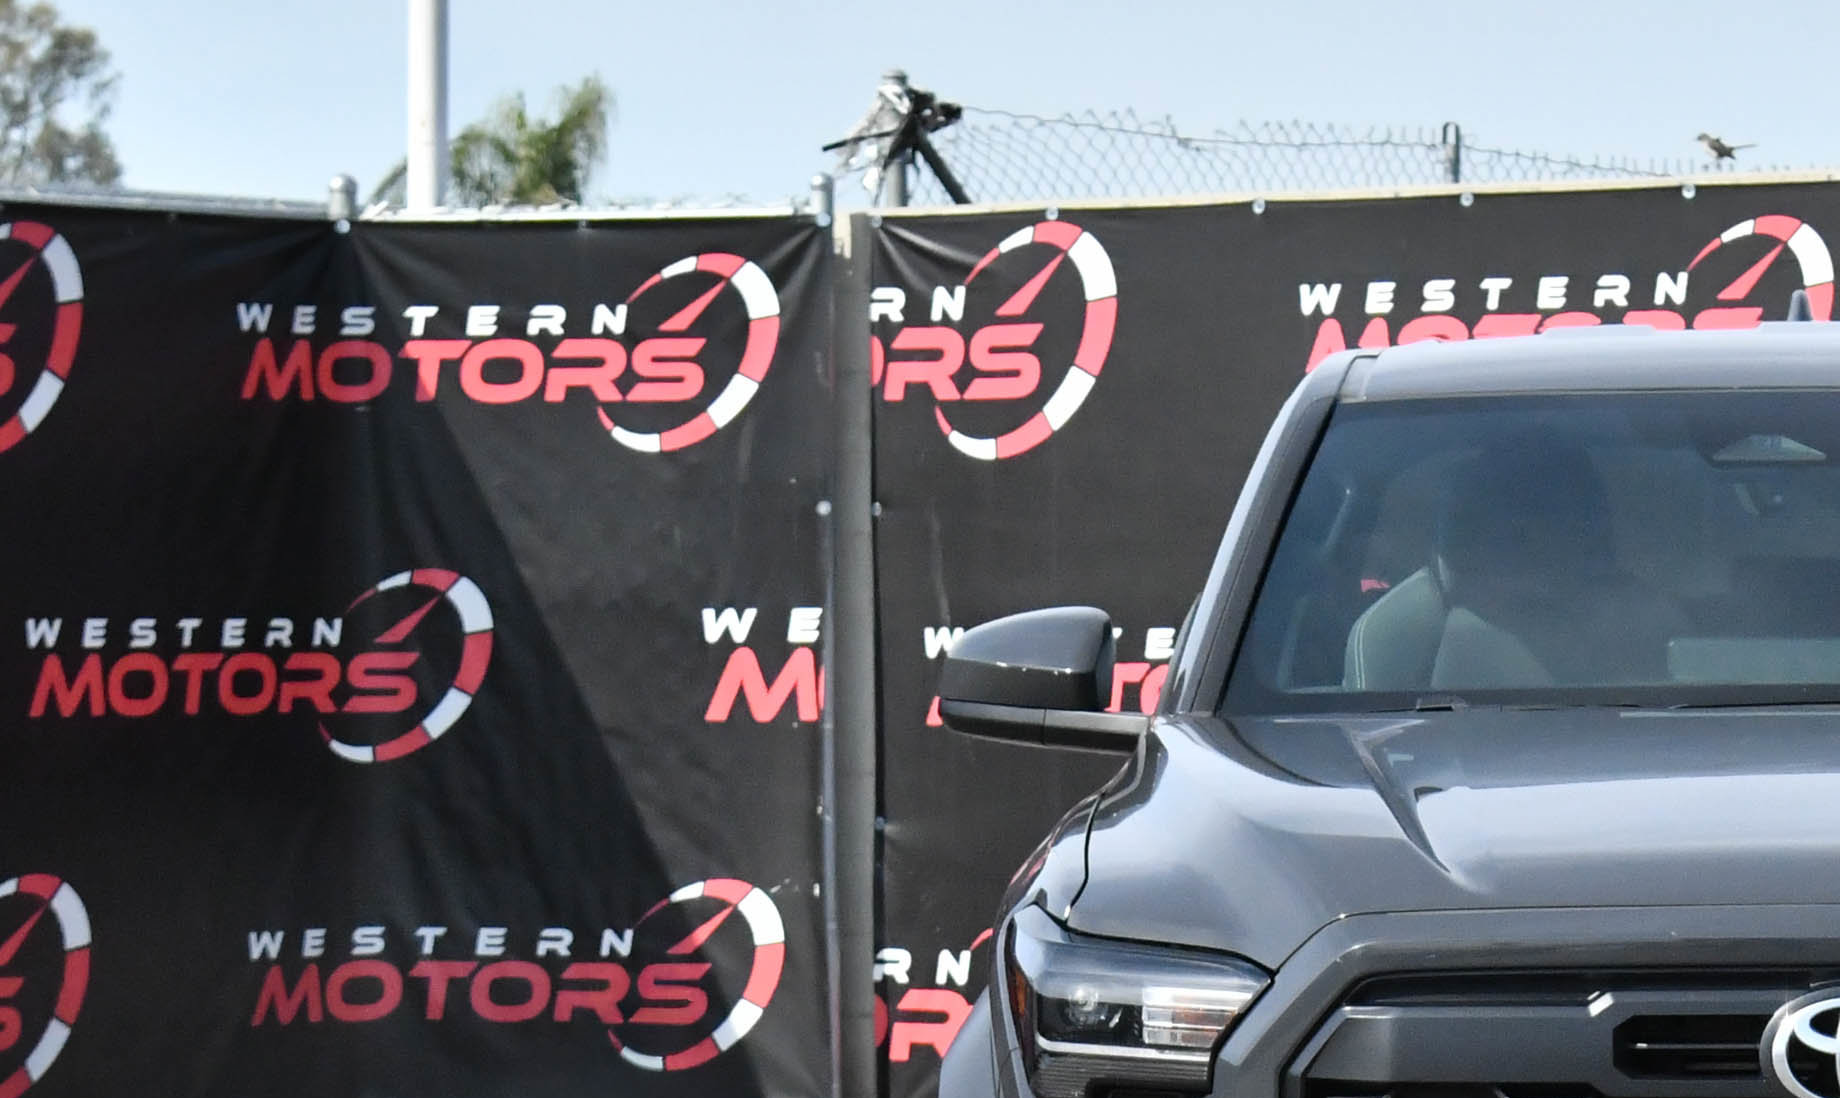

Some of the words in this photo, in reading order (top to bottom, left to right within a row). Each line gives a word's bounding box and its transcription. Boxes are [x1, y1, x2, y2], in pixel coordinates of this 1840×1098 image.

[238, 303, 628, 337] WESTERN
[1299, 271, 1688, 316] WESTERN
[242, 337, 706, 403] MOTORS
[871, 322, 1044, 402] RS
[25, 618, 344, 649] WESTERN
[702, 607, 823, 648] WE
[29, 652, 420, 718] MOTORS
[703, 645, 825, 723] M
[248, 926, 634, 960] WESTERN
[251, 960, 712, 1028] MOTORS
